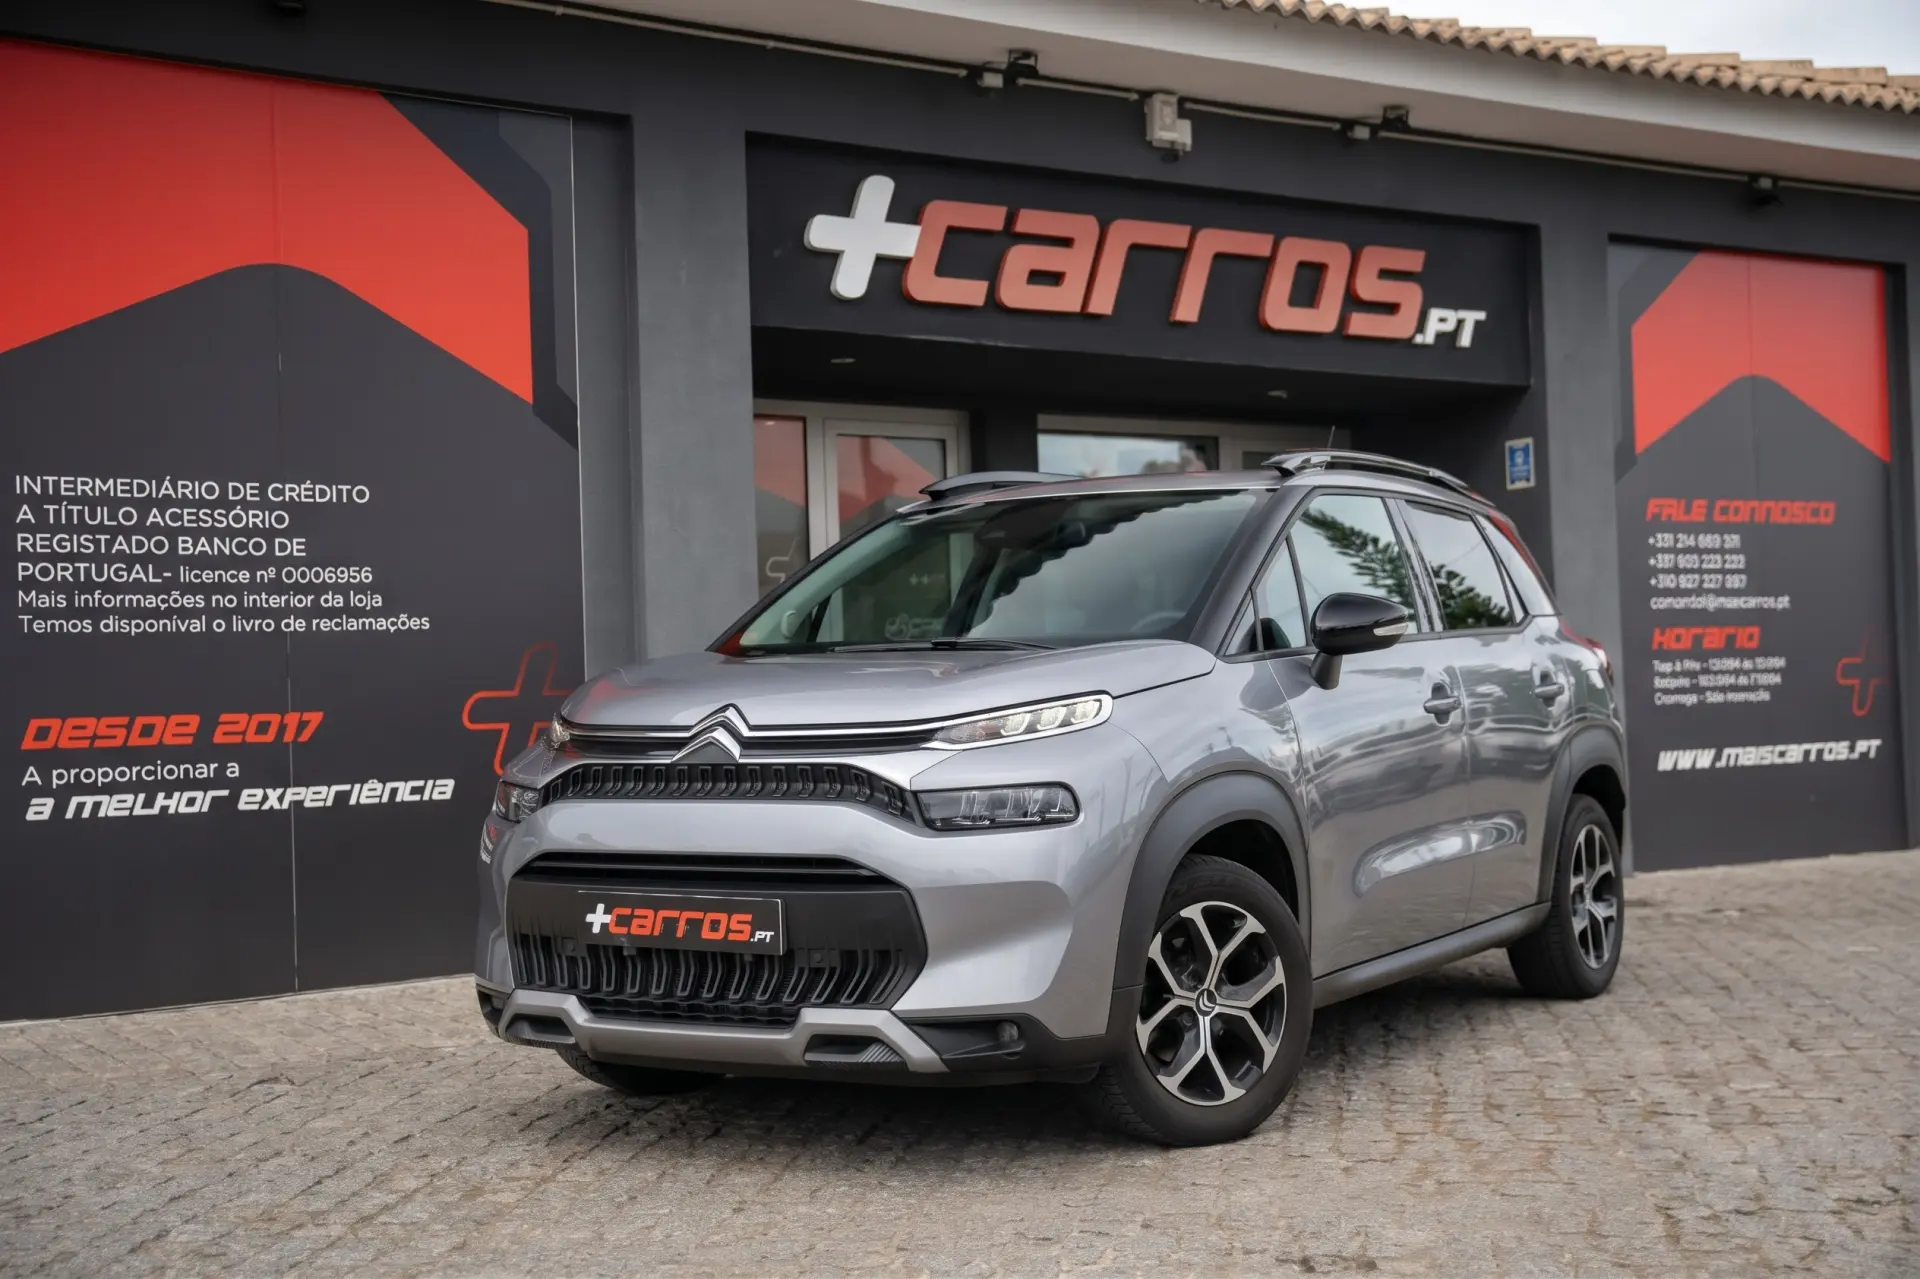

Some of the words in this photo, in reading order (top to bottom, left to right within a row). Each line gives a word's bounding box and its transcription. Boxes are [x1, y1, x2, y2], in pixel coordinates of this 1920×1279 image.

[14, 474, 221, 501] INTERMEDIÁRIO
[228, 481, 261, 501] DE
[267, 479, 370, 504] CRÉDITO
[15, 504, 36, 524] A
[43, 500, 138, 526] TÍTULO
[145, 505, 290, 529] ACESSÓRIO
[17, 533, 169, 555] REGISTADO
[177, 536, 267, 557] BANCO
[274, 537, 307, 557] DE
[179, 565, 251, 584] licence
[281, 566, 373, 584] 0006956
[18, 589, 67, 608] Mais
[74, 589, 206, 611] informações
[211, 594, 238, 608] no
[243, 590, 315, 608] interior
[319, 590, 344, 608] da
[349, 590, 383, 611] loja
[18, 615, 93, 634] Temos
[212, 618, 226, 633] o
[232, 614, 275, 632] livro
[280, 614, 307, 632] de
[312, 613, 430, 633] reclamações
[212, 711, 324, 744] 2017
[21, 765, 43, 786] A
[51, 759, 220, 789] proporcionar
[225, 762, 240, 778] a
[25, 797, 55, 821] a
